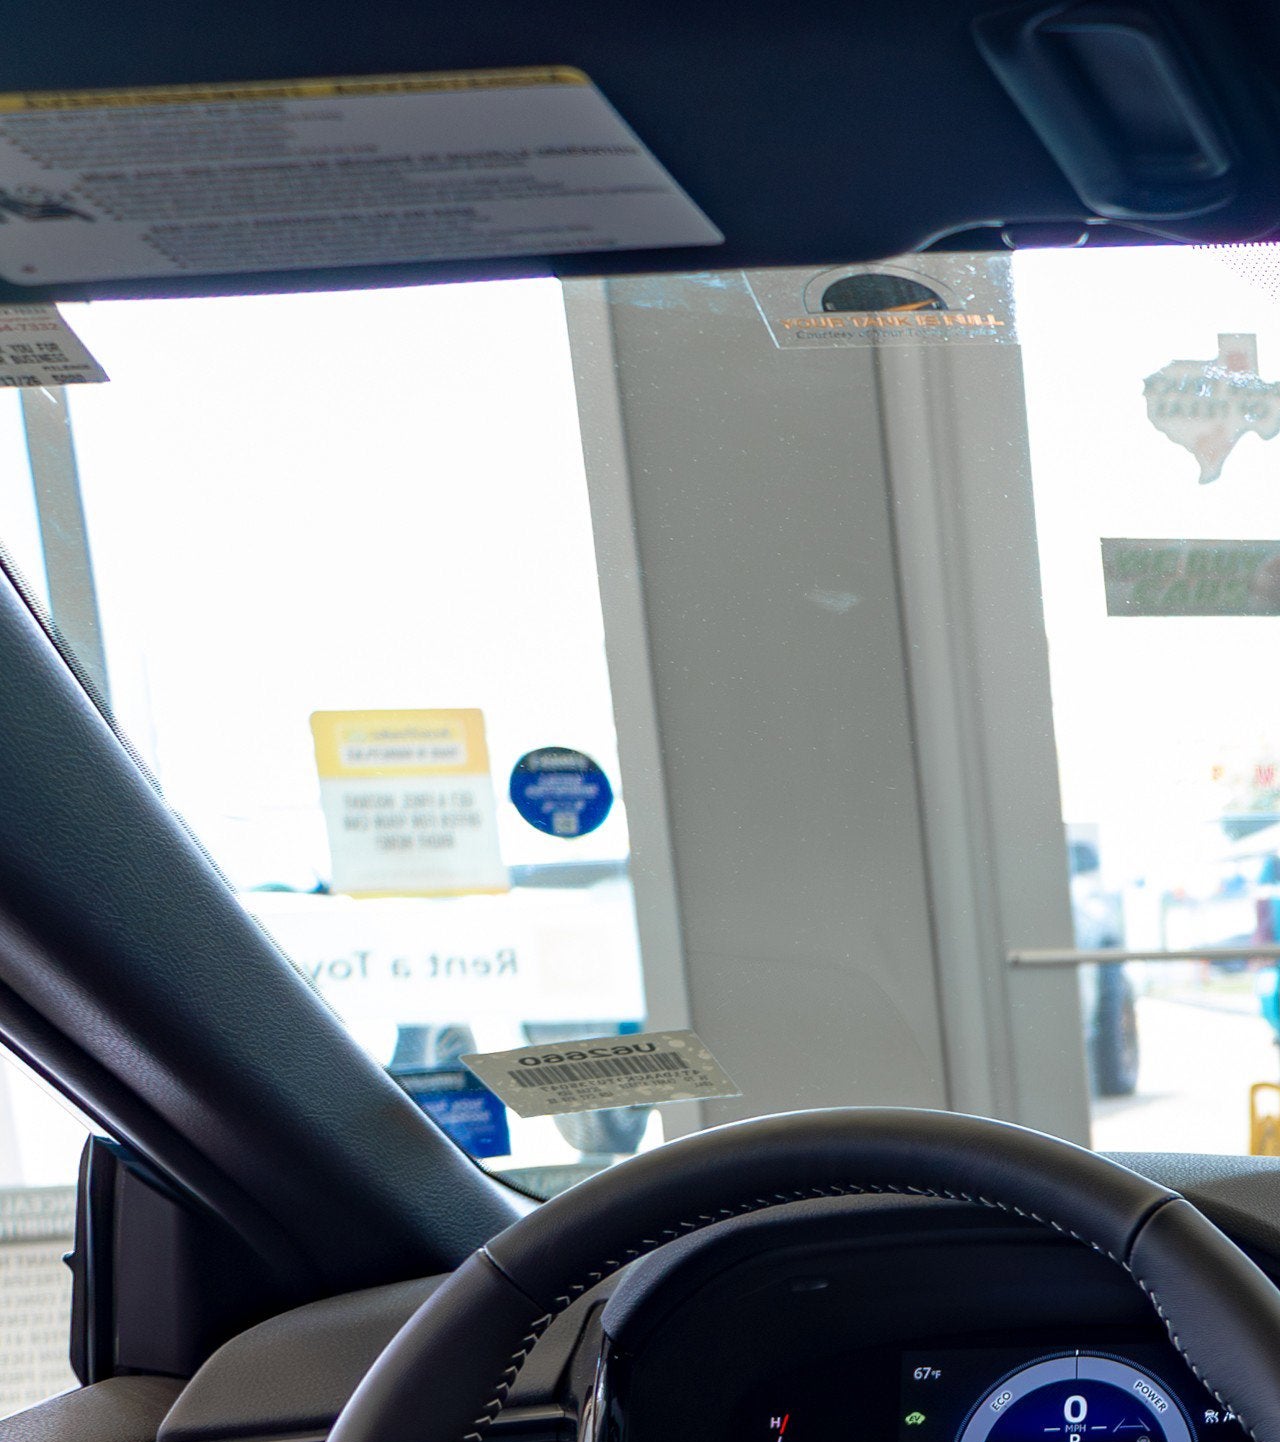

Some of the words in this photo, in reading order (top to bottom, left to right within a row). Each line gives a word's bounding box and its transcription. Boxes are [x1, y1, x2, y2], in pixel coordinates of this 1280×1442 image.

[853, 317, 910, 328] TANK
[992, 1391, 1012, 1411] ECO
[1135, 1381, 1166, 1412] POWER
[1063, 1395, 1088, 1424] 0
[770, 1416, 781, 1429] H
[1065, 1423, 1086, 1433] MPH
